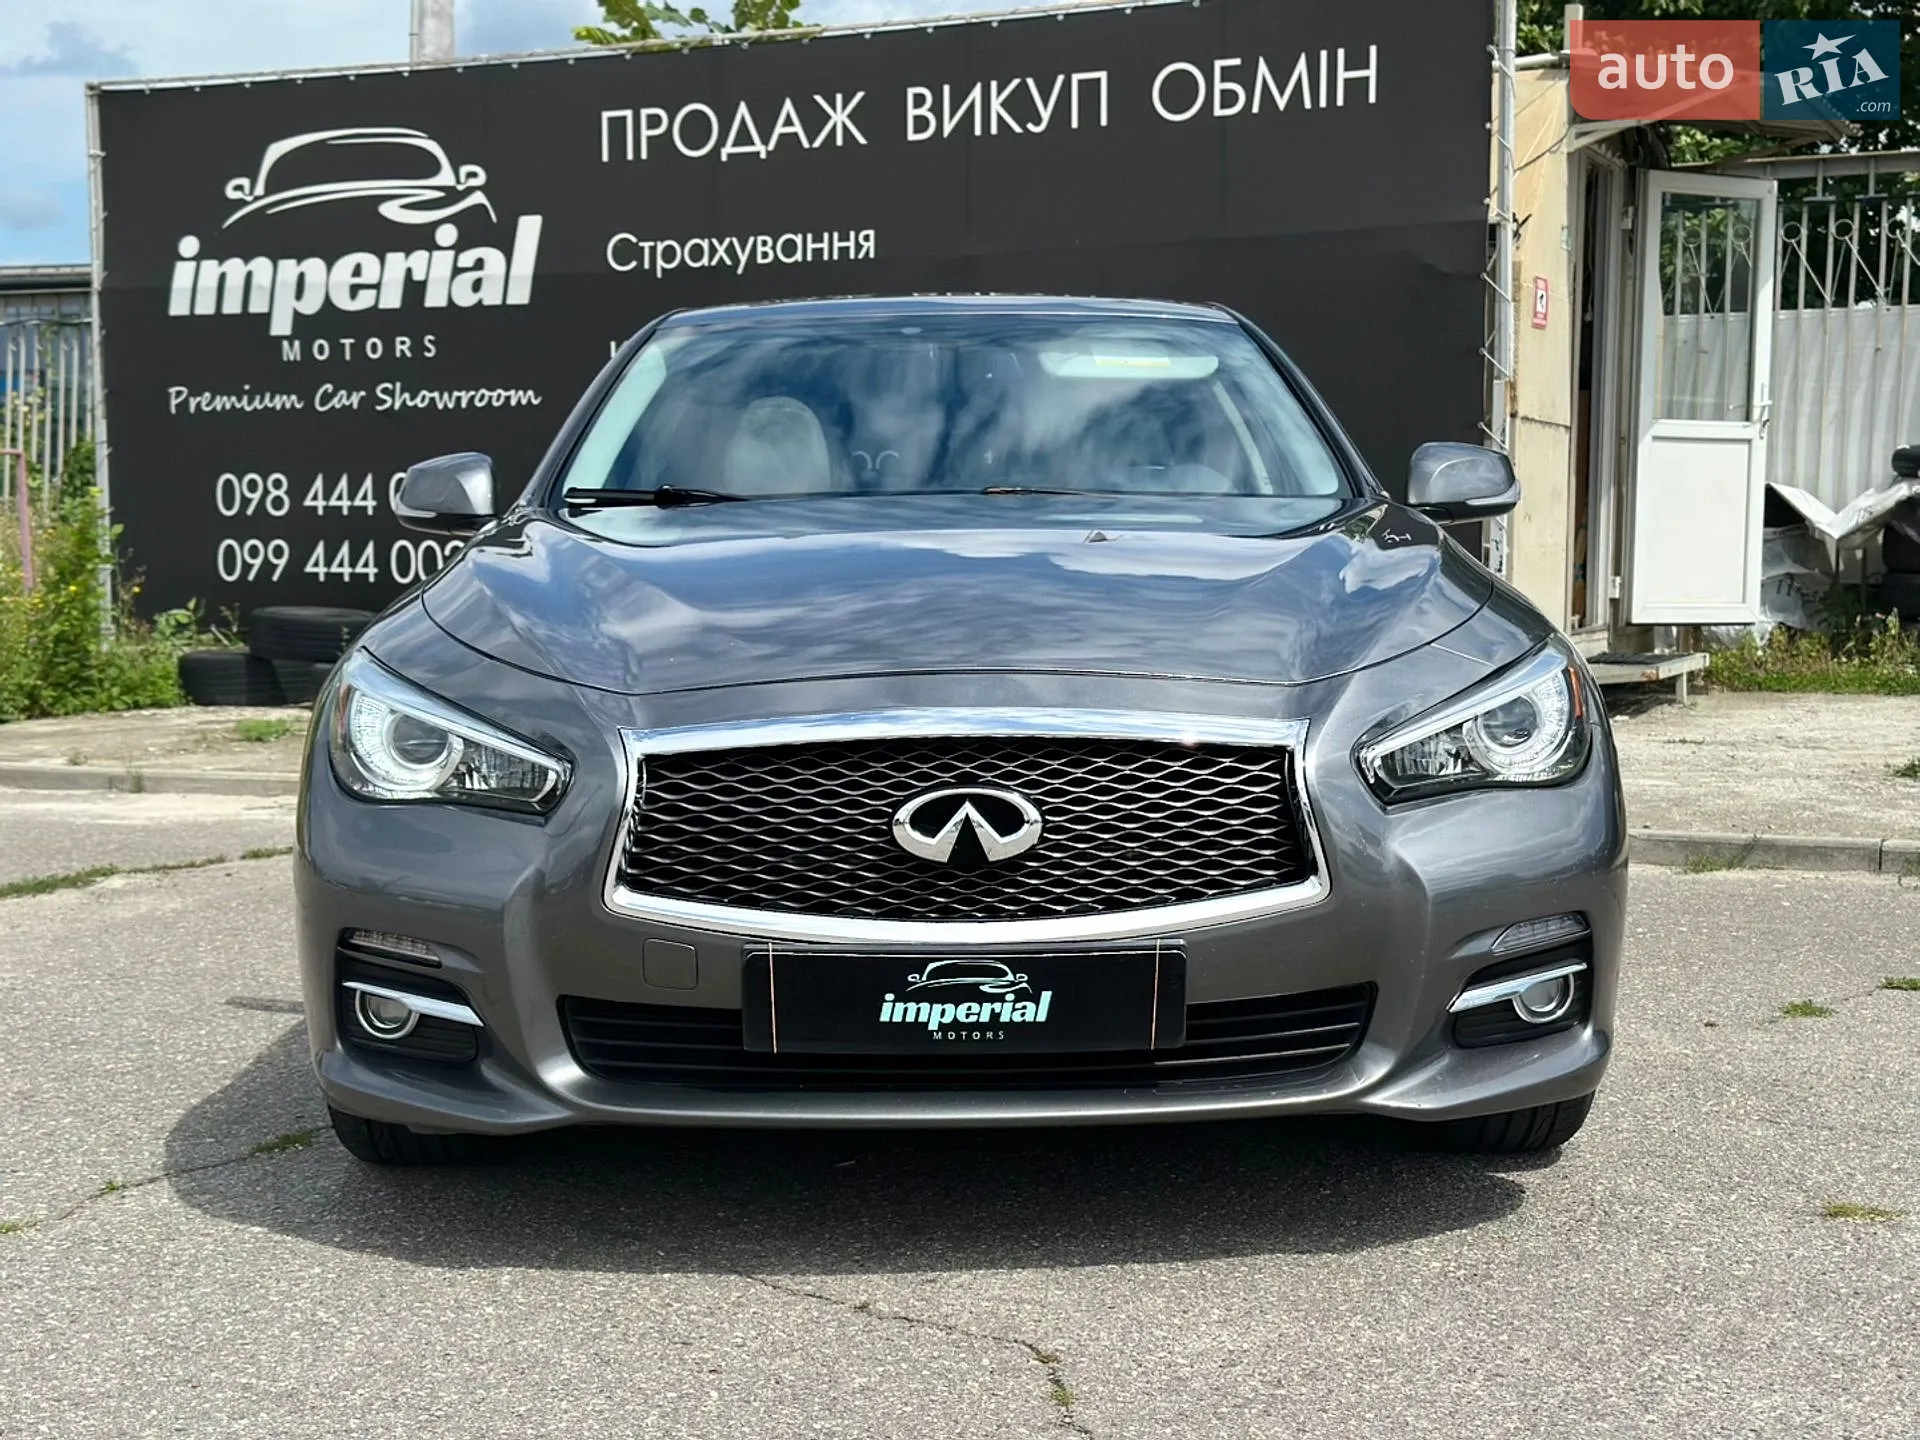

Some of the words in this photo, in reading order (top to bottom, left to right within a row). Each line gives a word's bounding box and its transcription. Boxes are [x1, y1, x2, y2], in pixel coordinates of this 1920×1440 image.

[601, 90, 868, 163] ПРОДАЖ
[906, 70, 1109, 142] ВИКУП
[1151, 44, 1379, 122] ОБМІН
[168, 214, 543, 336] imperial
[606, 228, 876, 279] Страхування
[281, 334, 438, 362] MOTORS
[167, 384, 304, 415] Premium
[313, 383, 367, 412] Car
[375, 382, 542, 411] Showroom
[216, 472, 291, 517] 098
[302, 472, 378, 516] 444
[217, 538, 290, 583] 099
[303, 539, 379, 583] 444
[878, 990, 1053, 1031] imperial
[932, 1031, 1005, 1040] MOTORS
